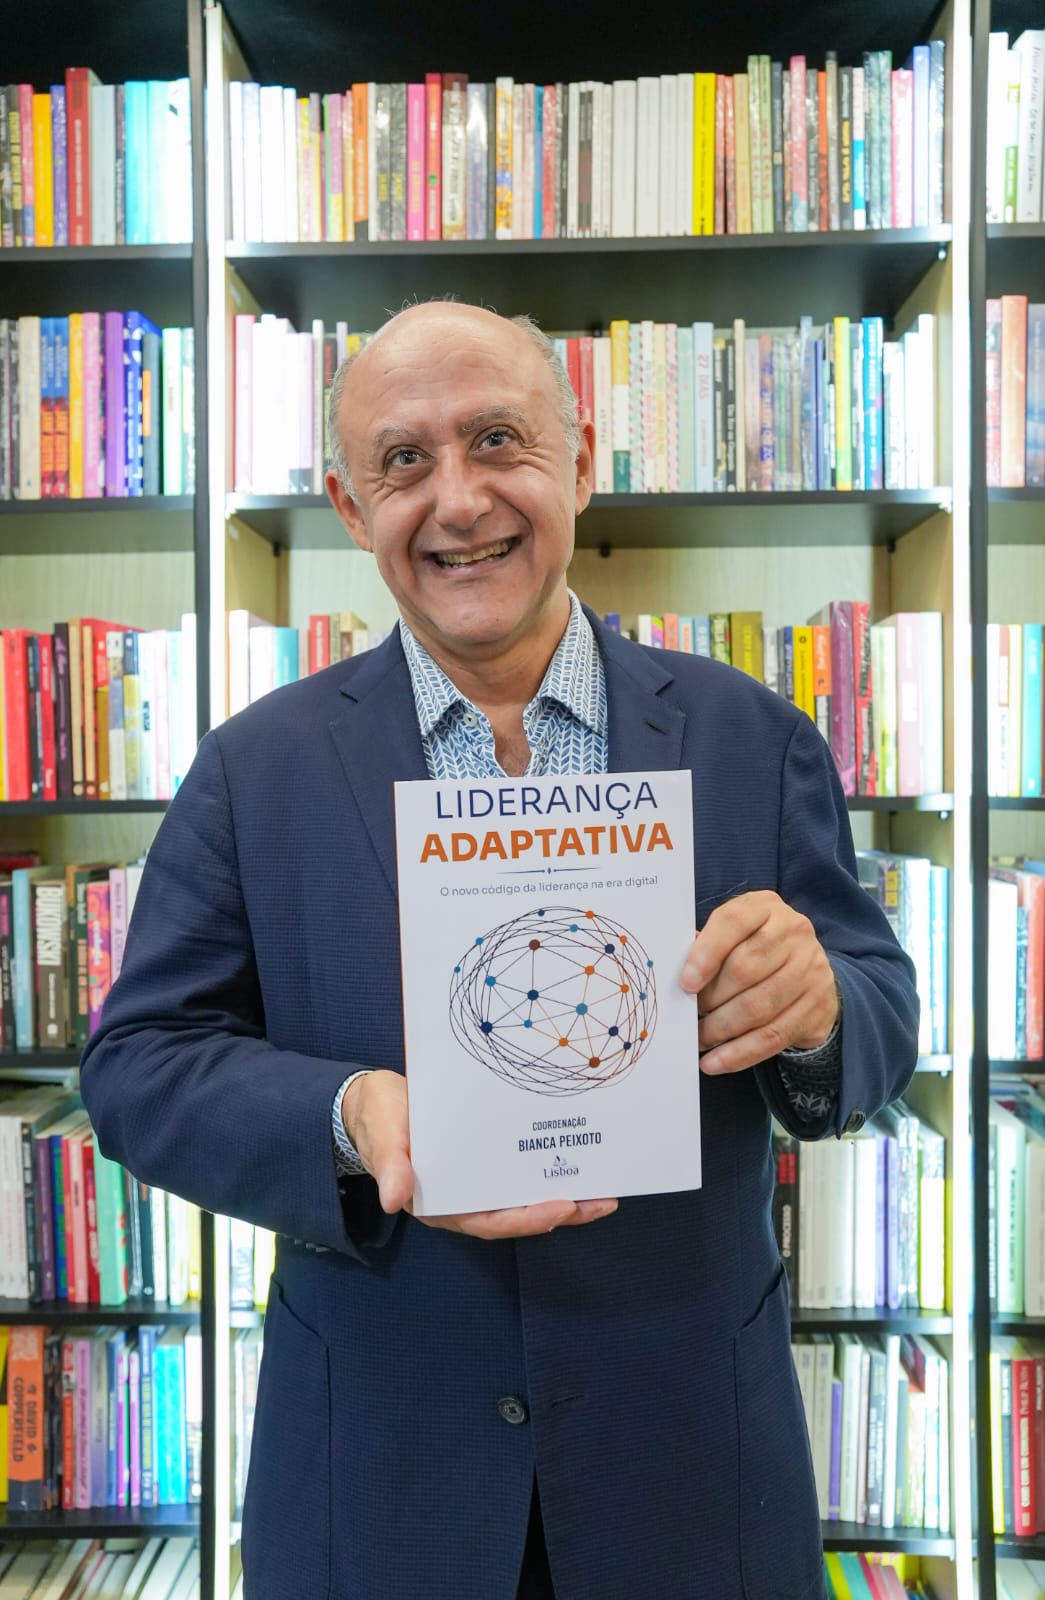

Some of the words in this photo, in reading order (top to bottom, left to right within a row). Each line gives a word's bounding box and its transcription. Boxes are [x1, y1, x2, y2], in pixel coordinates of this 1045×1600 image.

[436, 781, 658, 819] LIDERANÇA
[420, 822, 674, 863] ADAPTATIVA
[440, 886, 450, 897] O
[452, 886, 479, 896] novo
[481, 882, 521, 896] código
[523, 882, 537, 893] da
[539, 880, 589, 893] liderança
[591, 880, 604, 890] na
[606, 879, 623, 889] era
[625, 875, 659, 889] digital
[36, 886, 62, 966] BUKOWSKI
[532, 1116, 586, 1131] COORDENAÇÃO
[518, 1136, 556, 1152] BIANCA
[560, 1131, 602, 1148] PEIXOTO
[543, 1166, 579, 1179] Lisboa
[12, 1377, 24, 1462] COPPERFIELD
